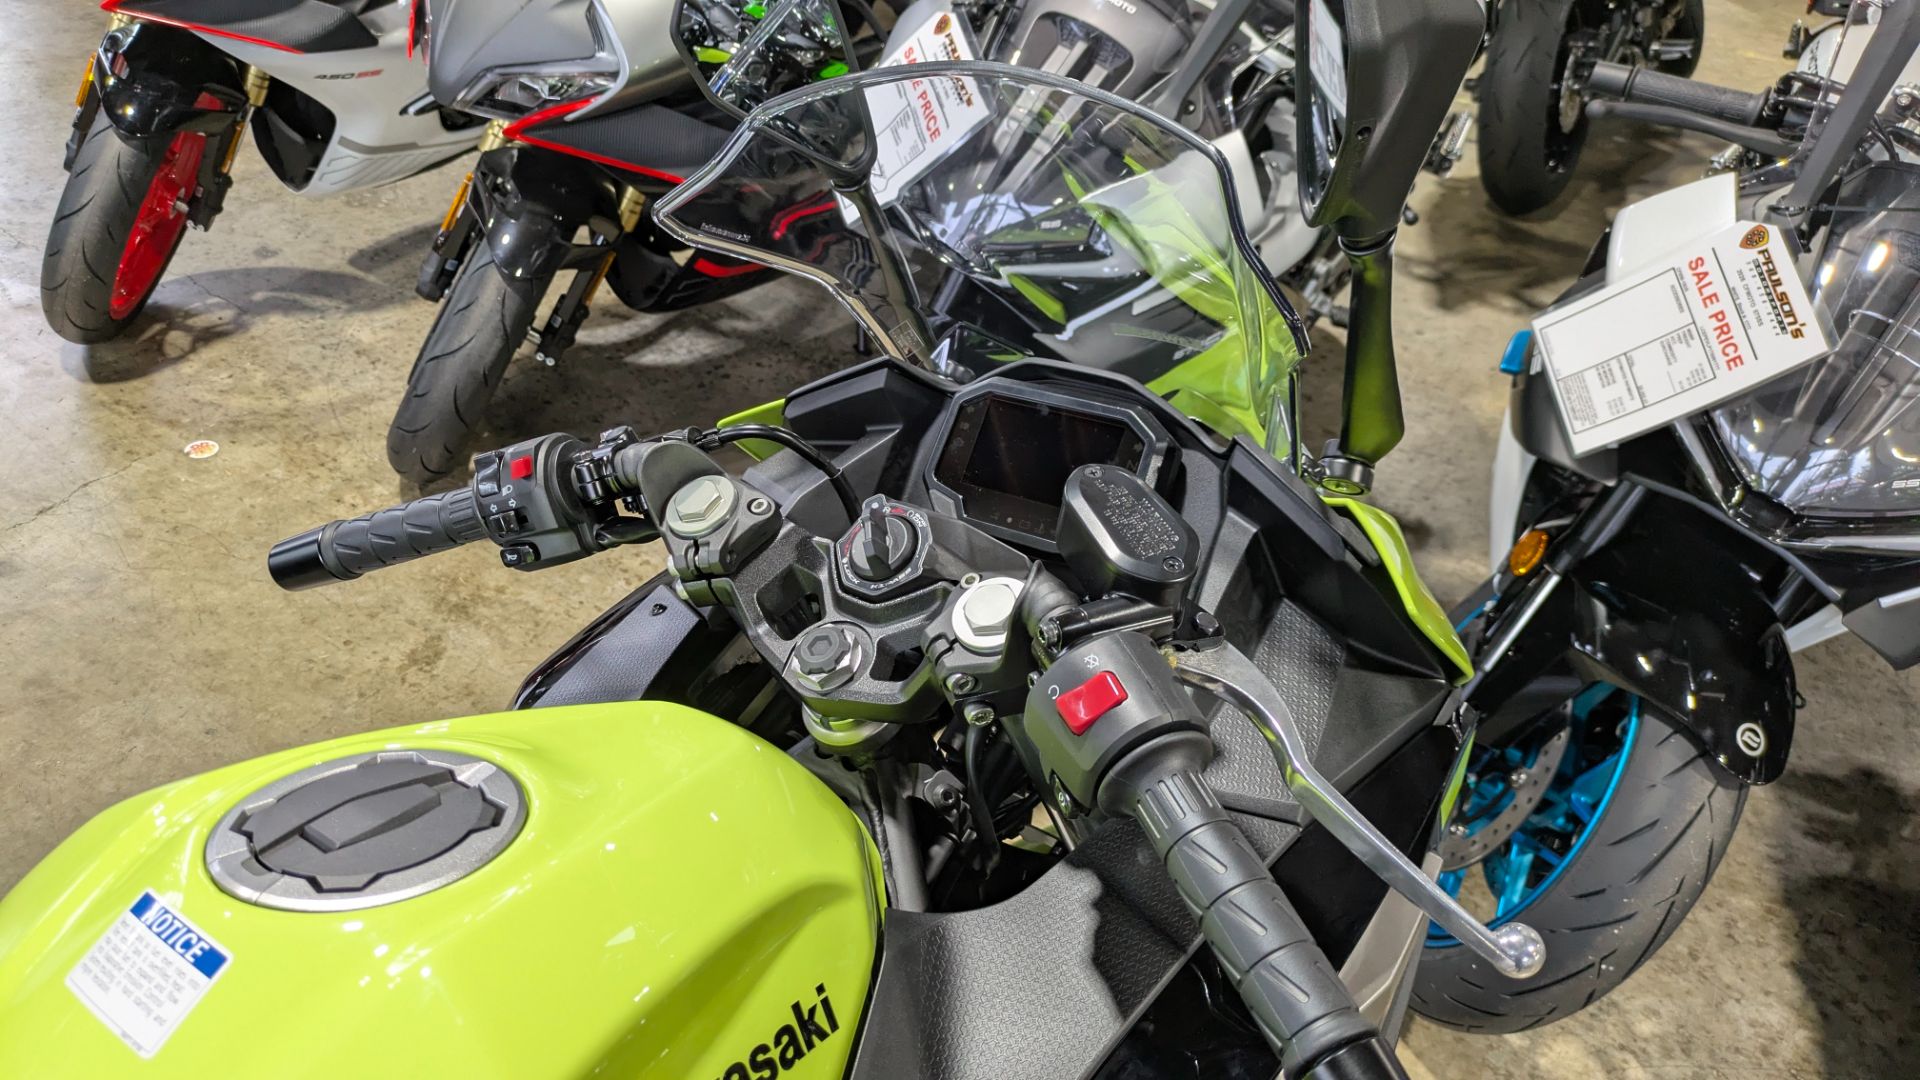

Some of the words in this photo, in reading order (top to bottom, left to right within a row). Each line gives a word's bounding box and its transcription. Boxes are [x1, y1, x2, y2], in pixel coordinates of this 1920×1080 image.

[917, 90, 941, 143] PRICE
[1687, 256, 1721, 309] SALE
[1708, 309, 1744, 371] PRICE
[1757, 248, 1807, 339] PAULSON'S
[844, 564, 860, 584] LOCK
[139, 902, 211, 963] NOTICE
[714, 982, 840, 1080] asaki
